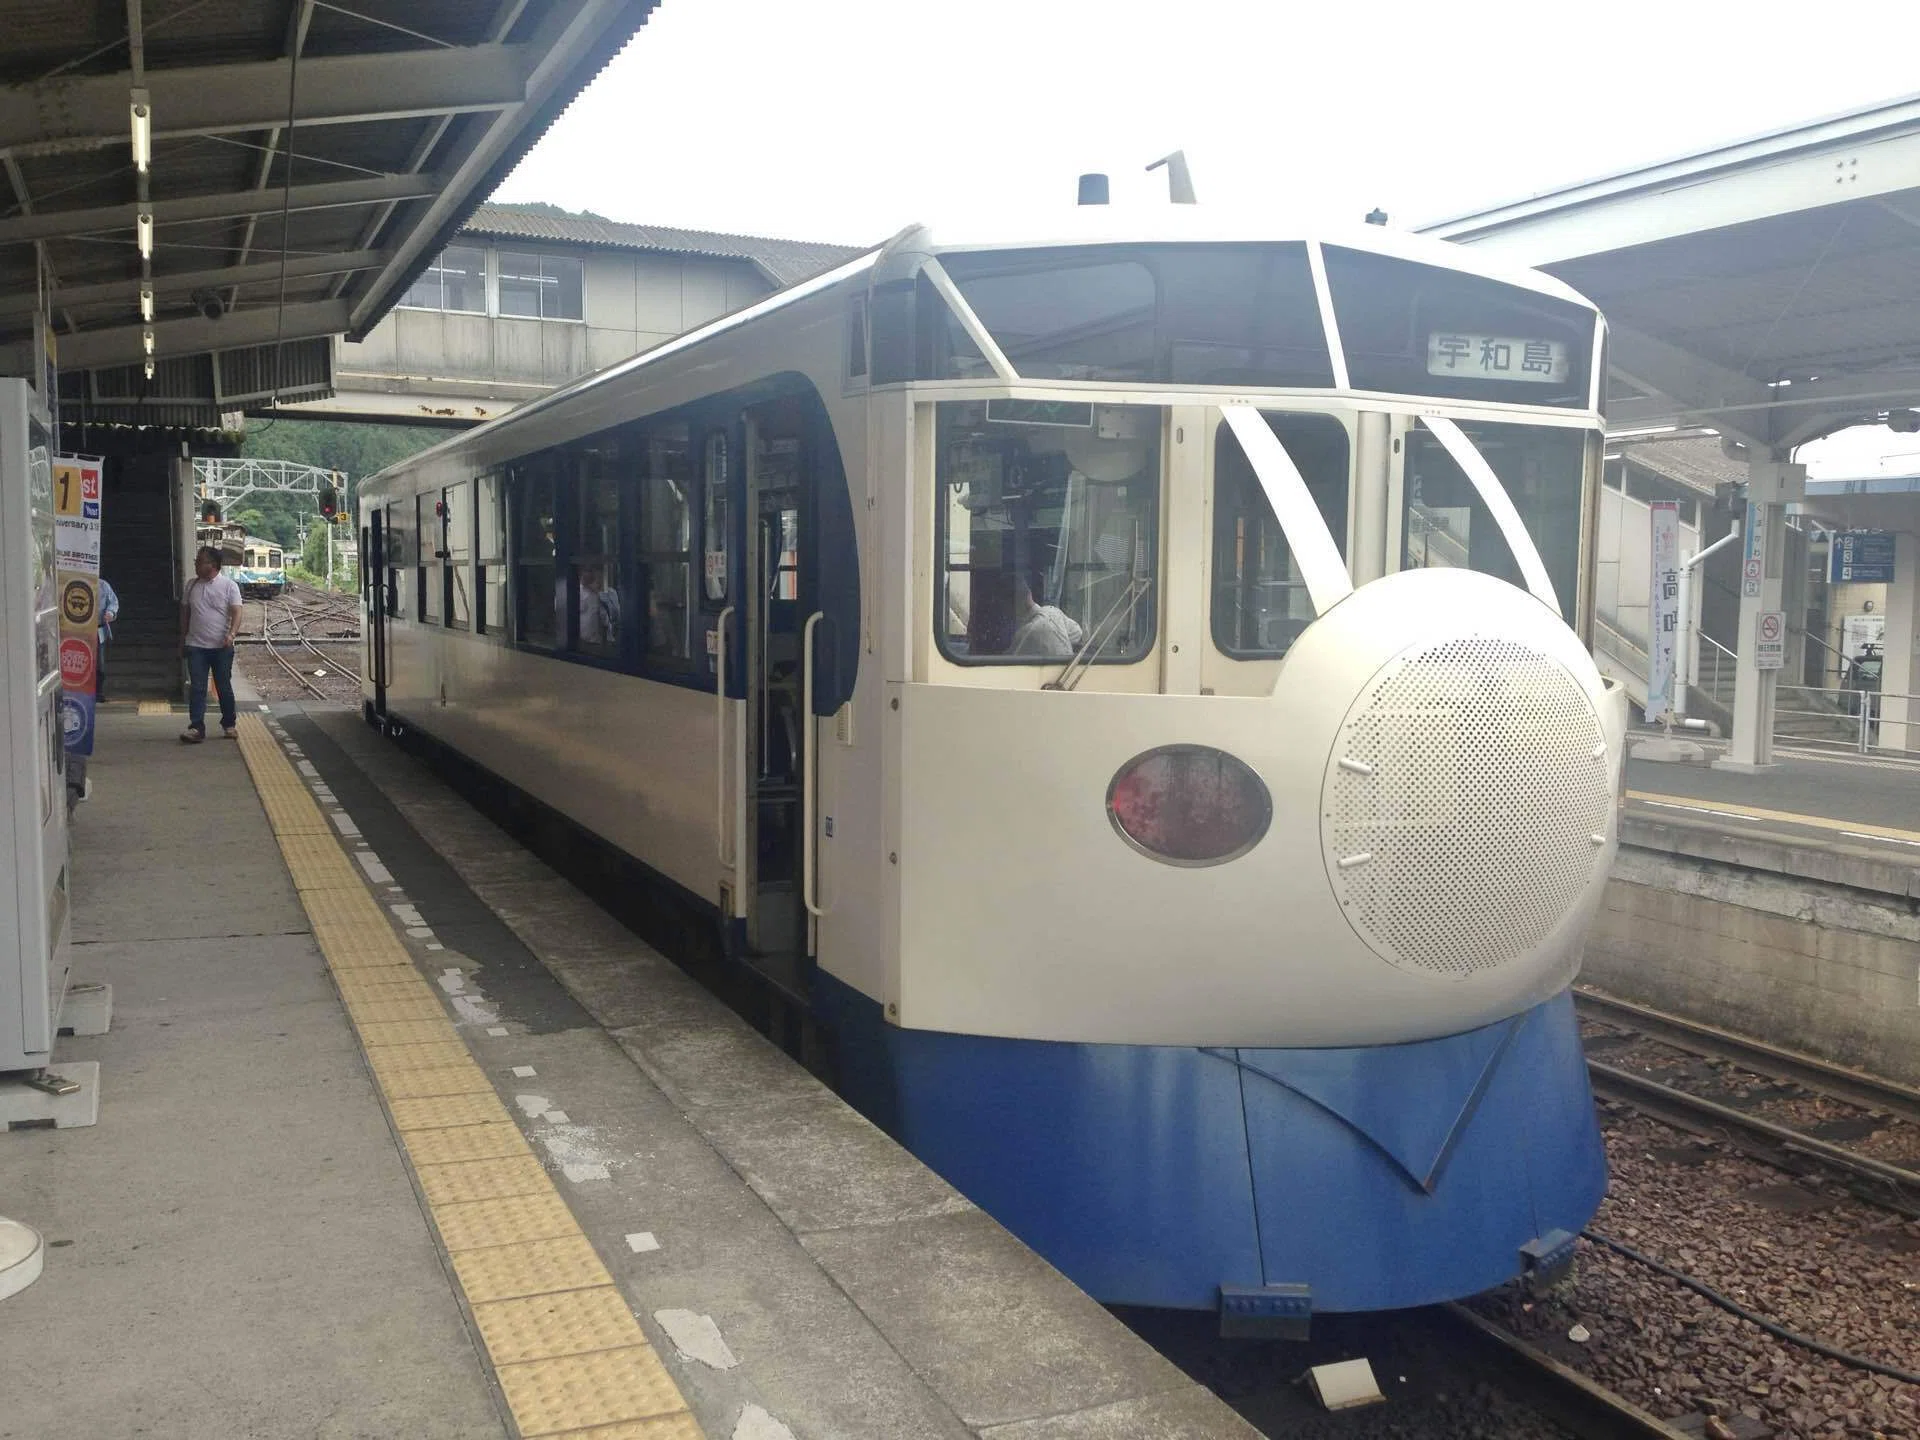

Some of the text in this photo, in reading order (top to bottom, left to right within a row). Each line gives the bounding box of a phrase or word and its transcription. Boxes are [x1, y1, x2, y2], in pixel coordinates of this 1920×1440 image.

[1438, 336, 1553, 375] 宇和島
[59, 472, 70, 510] 1
[83, 477, 96, 494] st
